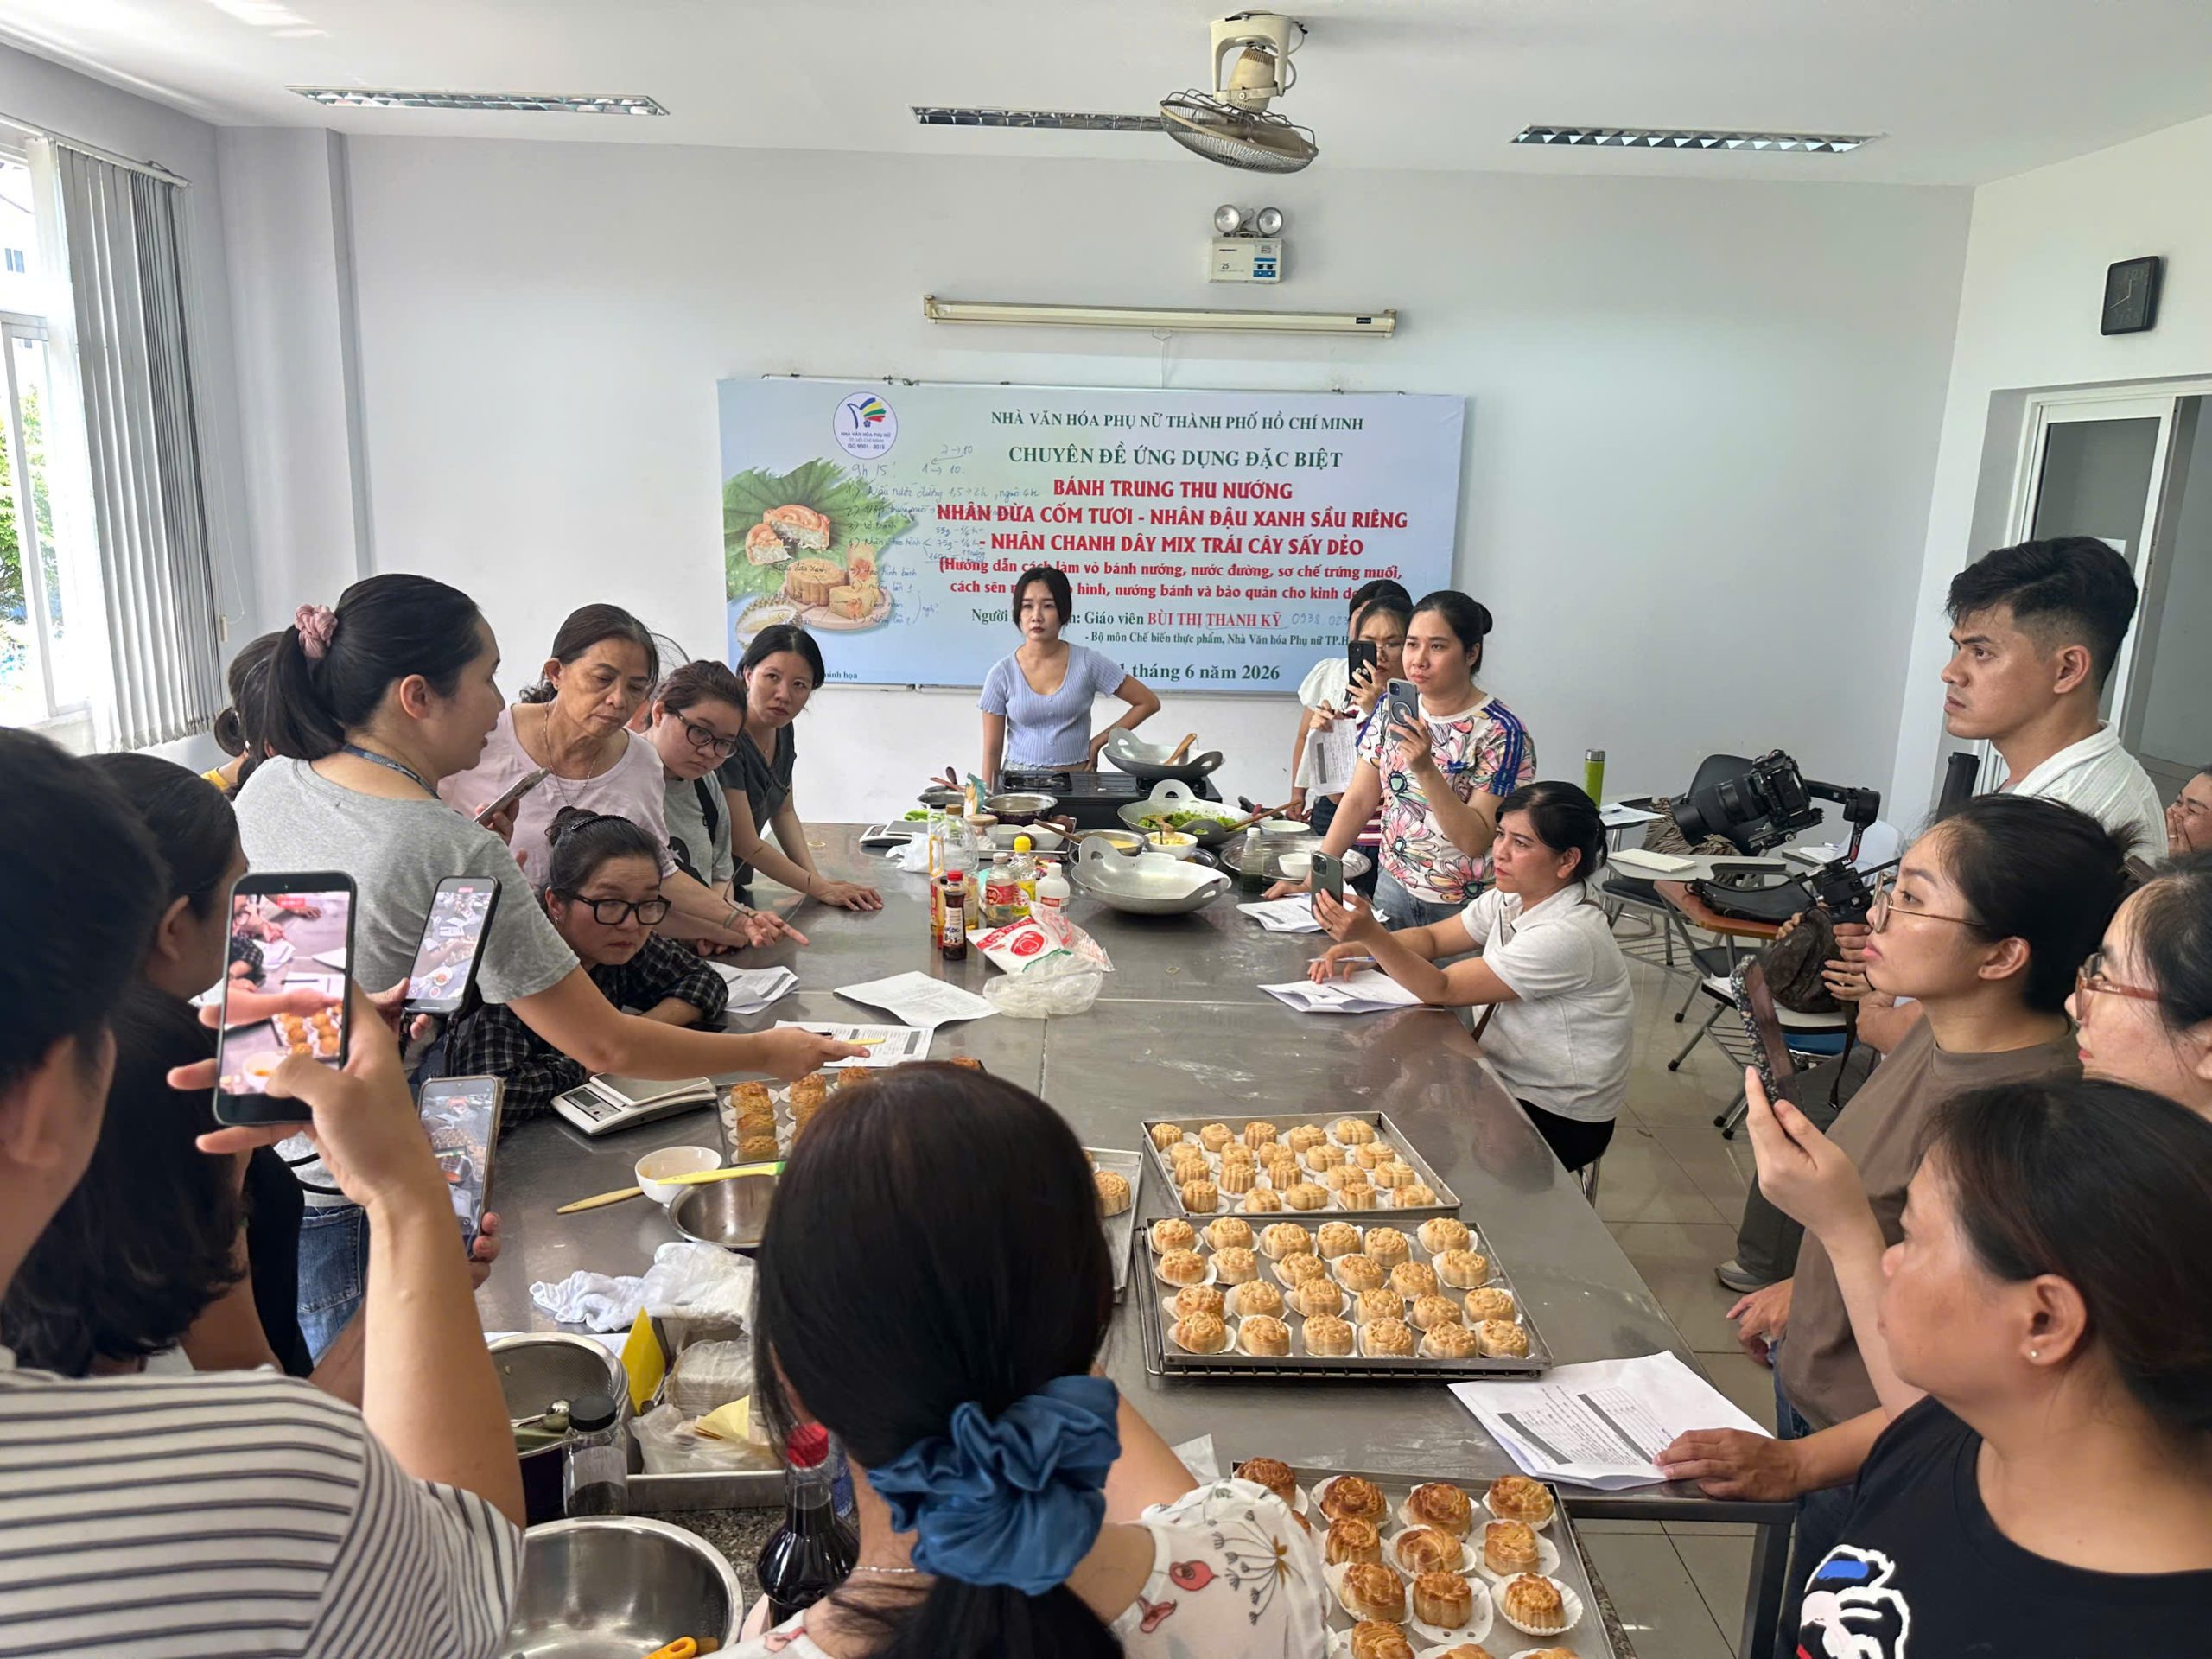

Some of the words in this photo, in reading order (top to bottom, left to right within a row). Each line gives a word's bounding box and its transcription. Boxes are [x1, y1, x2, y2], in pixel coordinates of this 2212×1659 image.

[991, 409, 1024, 424] NHÀ
[1030, 410, 1063, 426] VĂN
[1066, 410, 1100, 427] HÓA
[1103, 414, 1135, 429] PHỤ
[1140, 412, 1163, 429] NỮ
[1166, 412, 1221, 429] THÀNH
[1225, 411, 1258, 429] PHỐ
[1262, 410, 1284, 430] HỒ
[1288, 414, 1318, 430] CHÍ
[1321, 417, 1363, 430] MINH
[1008, 443, 1094, 464] CHUYÊN
[1099, 441, 1127, 464] ĐỀ
[1133, 444, 1176, 466] ỨNG
[1181, 450, 1239, 469] DỤNG
[1245, 448, 1289, 470] ĐẶC
[1294, 448, 1343, 470] BIỆT
[1053, 476, 1105, 497] BÁNH
[1110, 480, 1174, 498] TRUNG
[1180, 482, 1217, 499] THU
[1223, 479, 1293, 499] NƯỚNG
[937, 501, 991, 522] NHÂN
[1040, 502, 1083, 524] CỐM
[1088, 506, 1134, 524] TƯƠI
[1150, 506, 1205, 525] NHÂN
[1210, 506, 1248, 530] ĐẬU
[1253, 510, 1305, 527] XANH
[1351, 509, 1408, 529] RIÊNG
[991, 531, 1046, 550] NHÂN
[1051, 535, 1116, 552] CHANH
[1121, 532, 1156, 552] DÂY
[1161, 537, 1196, 553] MIX
[1201, 534, 1243, 554] TRÁI
[1248, 535, 1284, 555] CÂY
[1288, 534, 1323, 555] SẤY
[1327, 533, 1363, 556] DẺO
[992, 558, 1017, 572] dẫn
[1056, 561, 1080, 574] làm
[1084, 560, 1100, 574] vỏ
[1104, 561, 1137, 575] bánh
[1141, 564, 1186, 578] nướng,
[1191, 563, 1224, 576] nước
[1227, 563, 1274, 579] đường,
[1278, 566, 1294, 577] sơ
[1297, 563, 1323, 578] chế
[1324, 566, 1360, 580] trứng
[1363, 564, 1402, 580] muối,
[950, 579, 981, 593] cách
[984, 579, 1006, 594] sên
[1077, 582, 1110, 597] hình,
[1115, 583, 1156, 598] nướng
[1160, 583, 1193, 598] bánh
[1197, 585, 1211, 598] và
[1216, 584, 1241, 598] bảo
[1245, 586, 1277, 601] quản
[1282, 586, 1306, 599] cho
[1310, 586, 1338, 600] kinh
[971, 609, 1008, 626] Người
[1084, 611, 1115, 625] Giáo
[1118, 612, 1144, 625] viên
[1147, 609, 1173, 626] BÙI
[1178, 613, 1202, 628] THỊ
[1206, 613, 1257, 627] THANH
[1261, 611, 1282, 627] KỸ
[1090, 632, 1104, 644] Bộ
[1106, 632, 1128, 642] môn
[1129, 631, 1150, 643] Chế
[1151, 631, 1171, 643] biến
[1173, 633, 1194, 645] thực
[1197, 632, 1225, 645] phẩm,
[1227, 633, 1246, 645] Nhà
[1249, 633, 1268, 645] Văn
[1270, 634, 1287, 645] hóa
[1289, 635, 1307, 647] Phụ
[1311, 635, 1324, 646] nữ
[1325, 636, 1349, 646] TP.H
[1133, 663, 1180, 682] tháng
[1185, 664, 1195, 679] 6
[1199, 664, 1236, 679] năm
[1242, 665, 1281, 681] 2026
